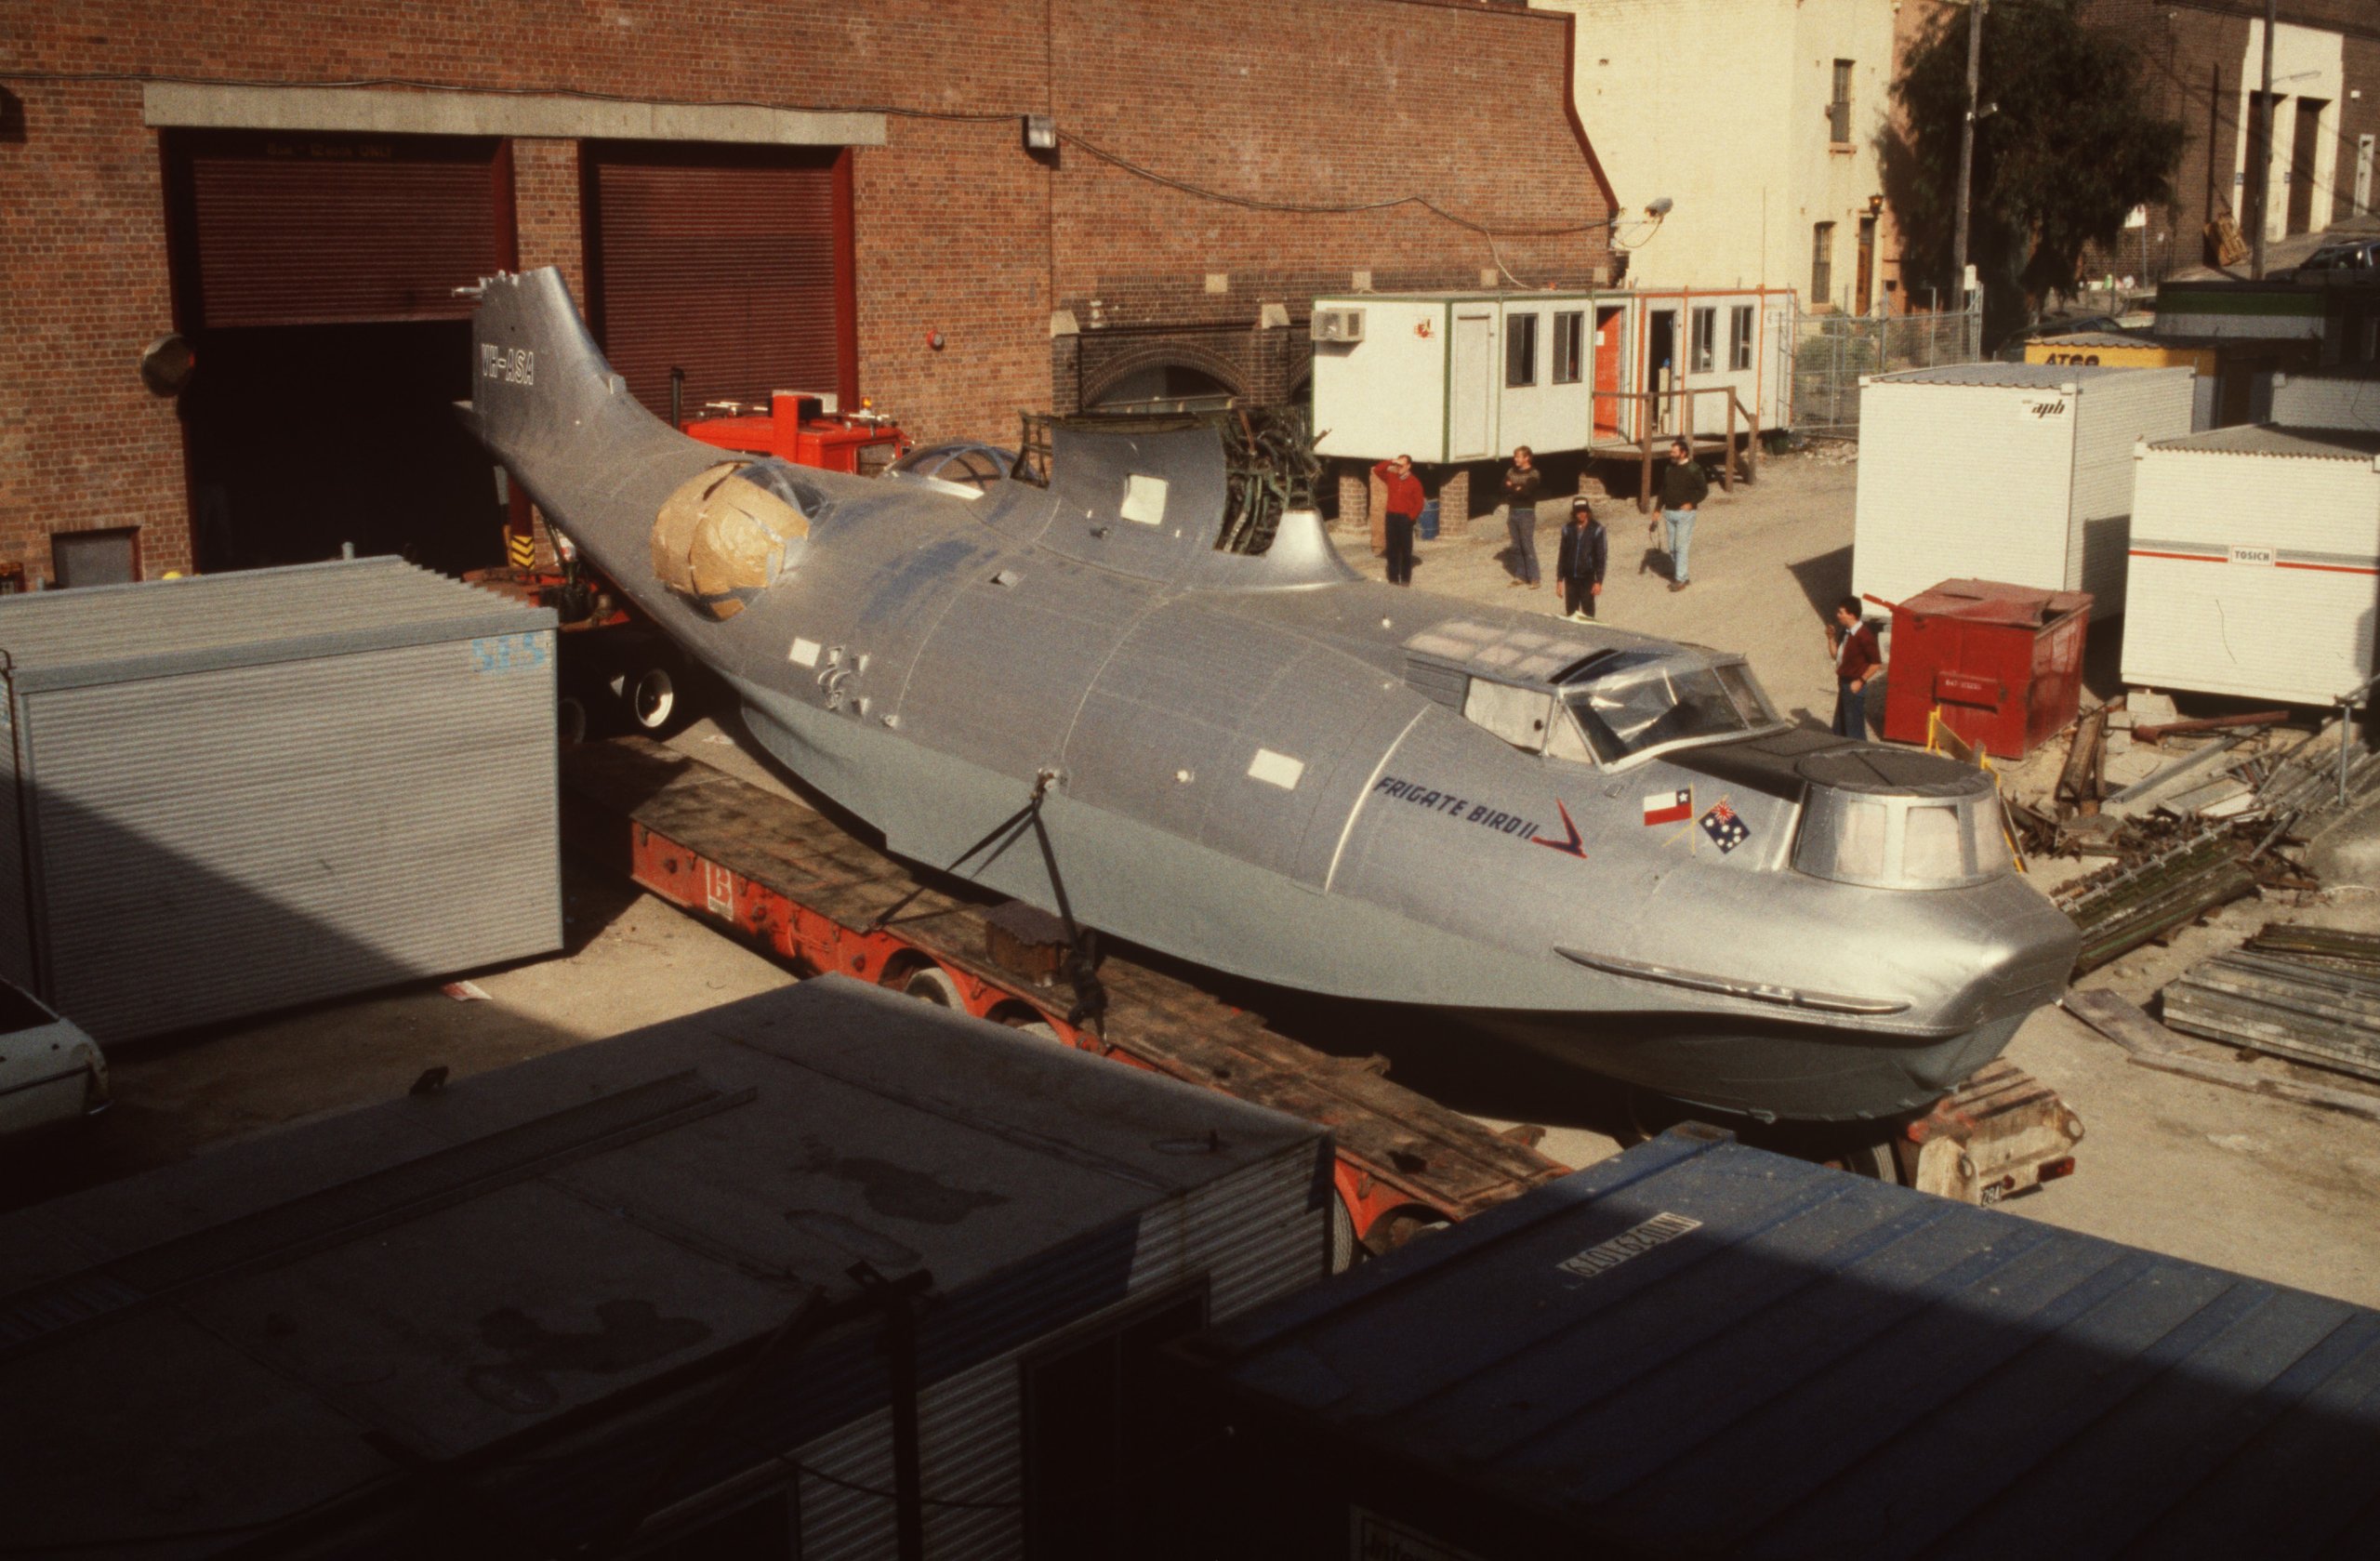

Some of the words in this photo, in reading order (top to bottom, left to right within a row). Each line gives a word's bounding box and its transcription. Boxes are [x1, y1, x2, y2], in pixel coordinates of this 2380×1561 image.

[482, 343, 534, 386] VH-ASA
[2235, 550, 2269, 561] TOSICH
[1374, 776, 1467, 816] FRIGATE
